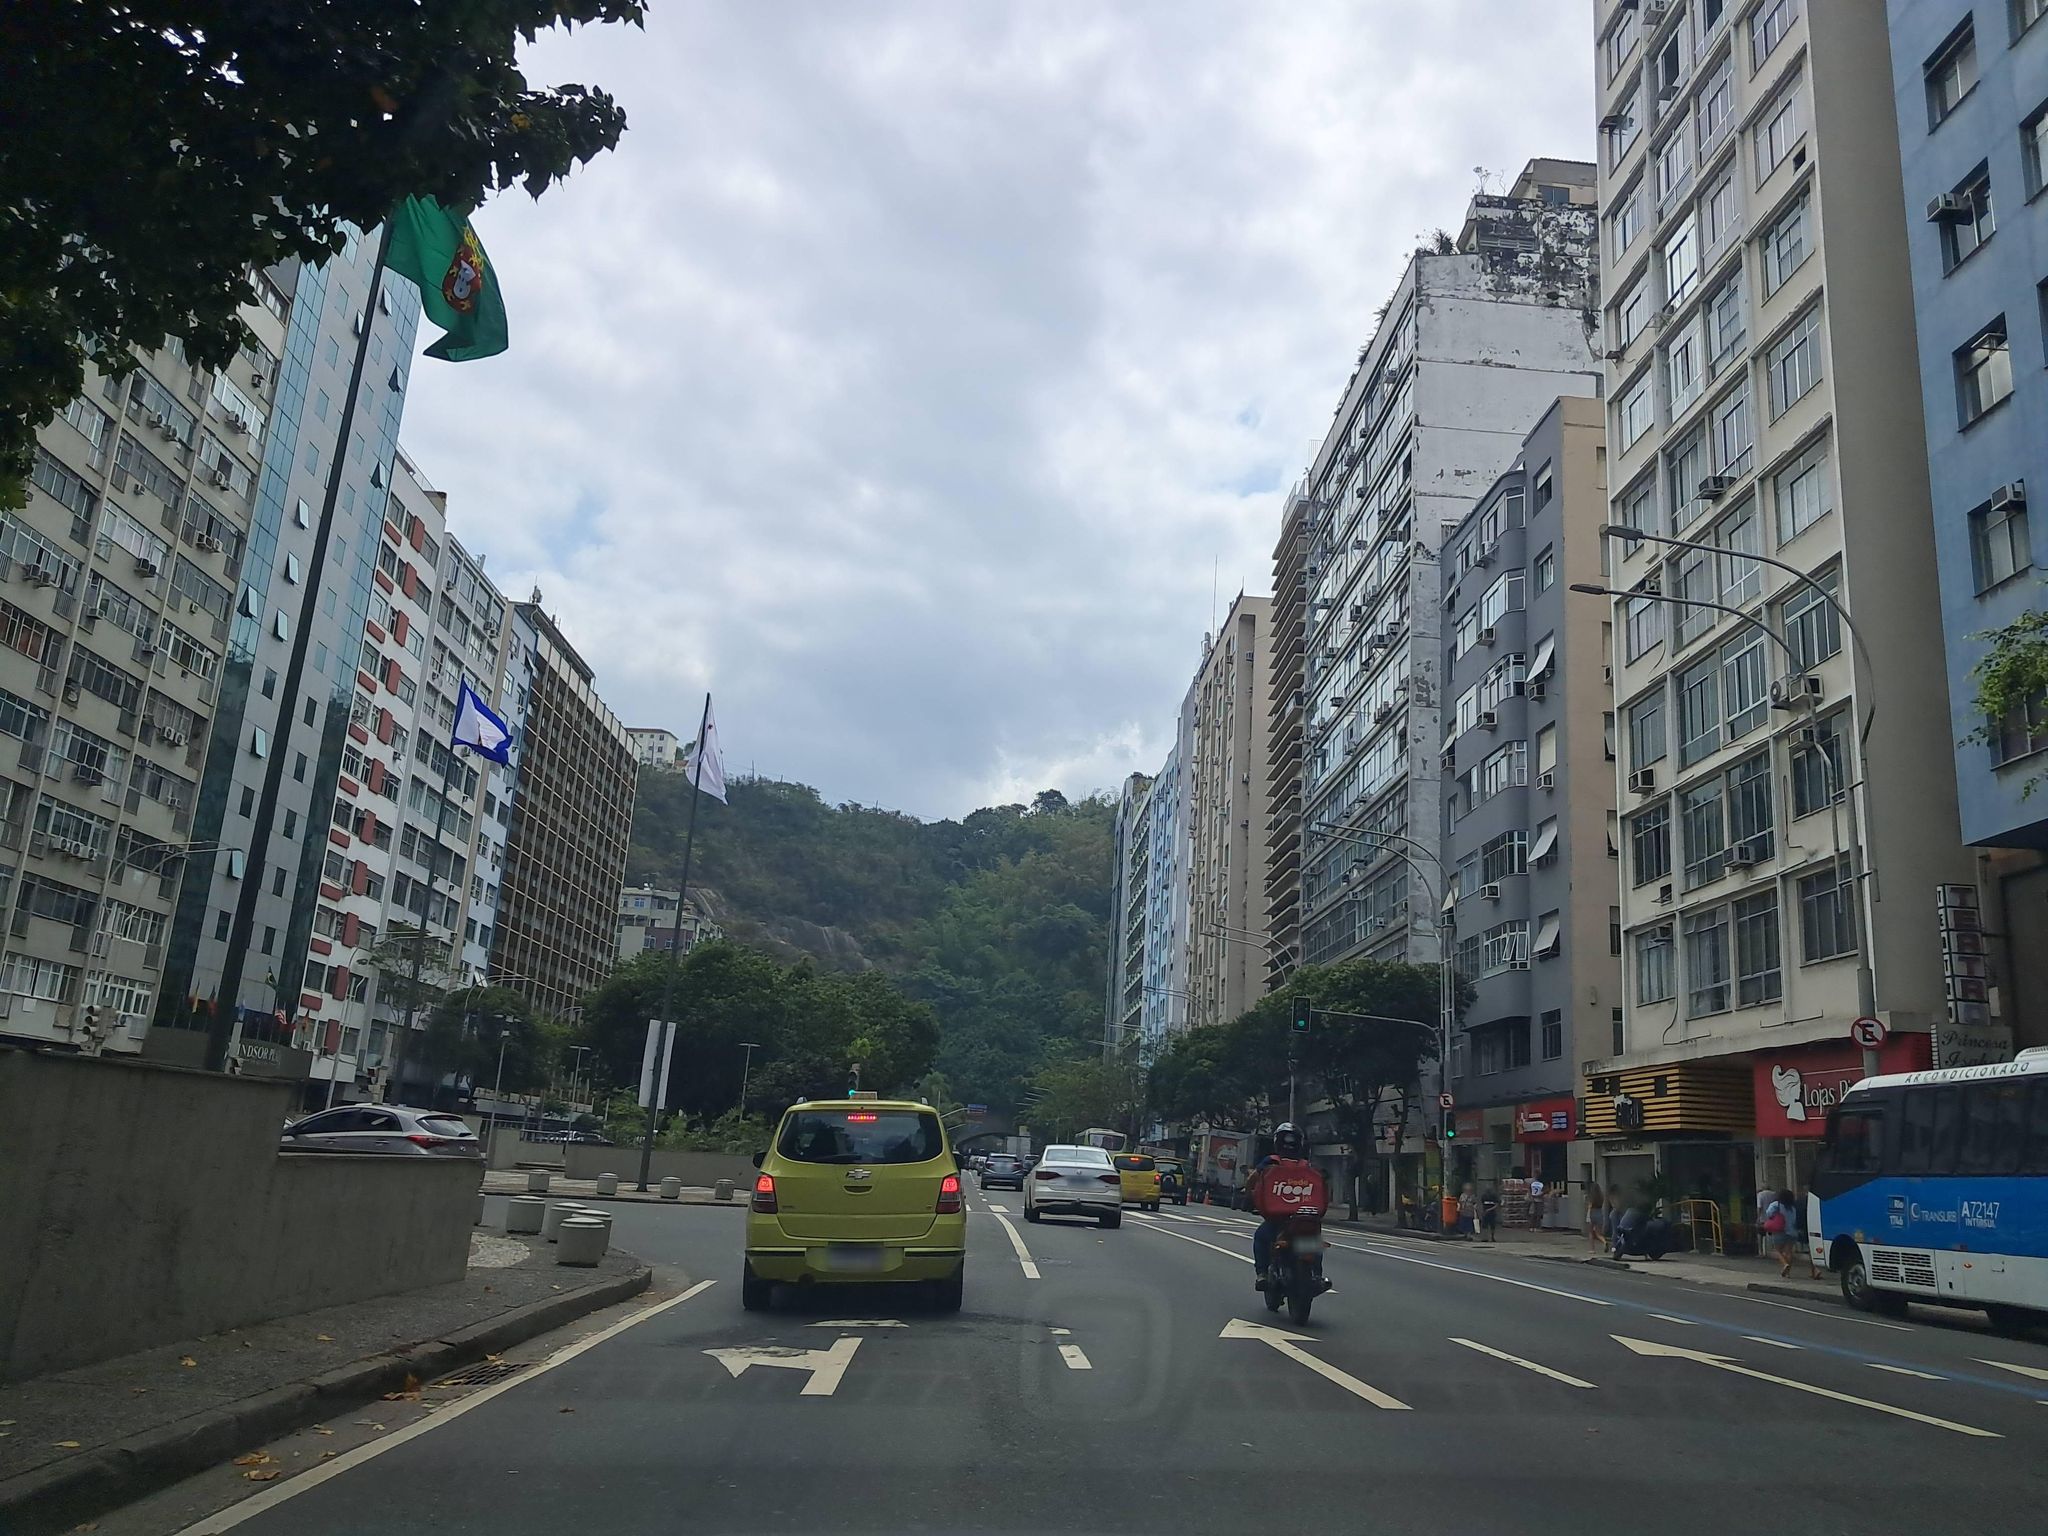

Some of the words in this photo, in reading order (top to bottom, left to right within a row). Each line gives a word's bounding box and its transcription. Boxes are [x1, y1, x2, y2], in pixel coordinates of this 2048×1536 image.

[1941, 1030, 2008, 1050] Princesa
[1803, 1082, 1835, 1116] Lojas
[1961, 1200, 2000, 1220] A72147
